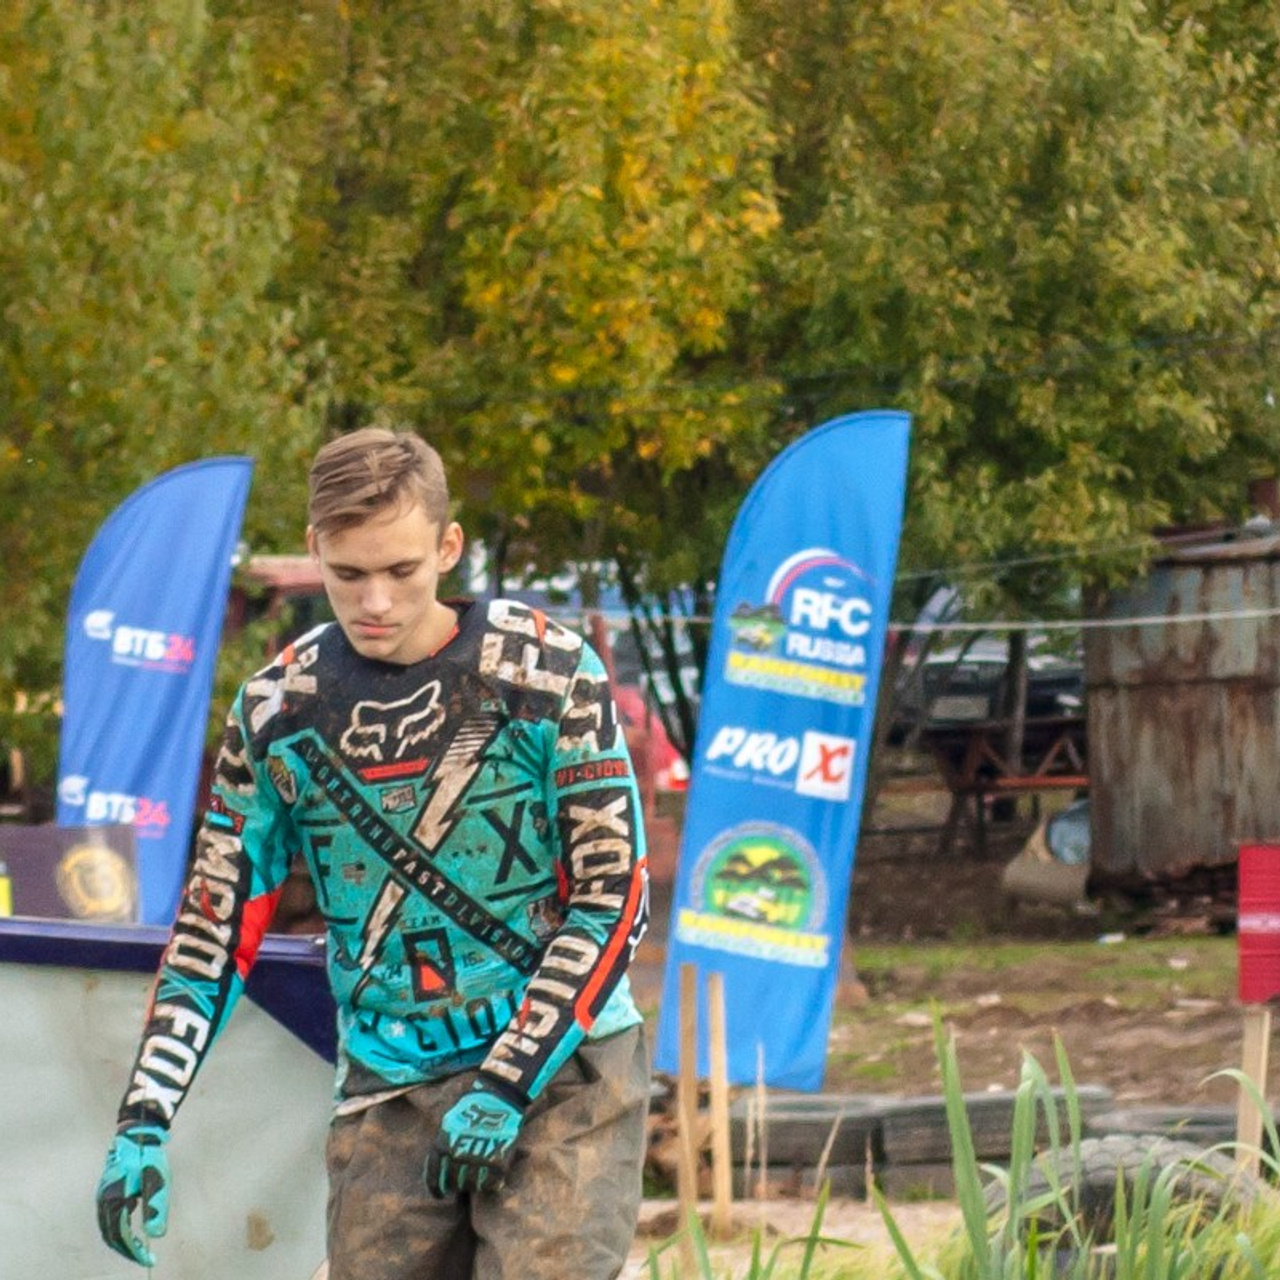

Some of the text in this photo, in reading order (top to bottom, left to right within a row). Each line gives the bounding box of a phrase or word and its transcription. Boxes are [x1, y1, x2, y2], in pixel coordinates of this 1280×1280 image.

[791, 587, 872, 637] RFC
[706, 726, 799, 775] PRO
[803, 743, 850, 782] X
[126, 1001, 213, 1122] FOX
